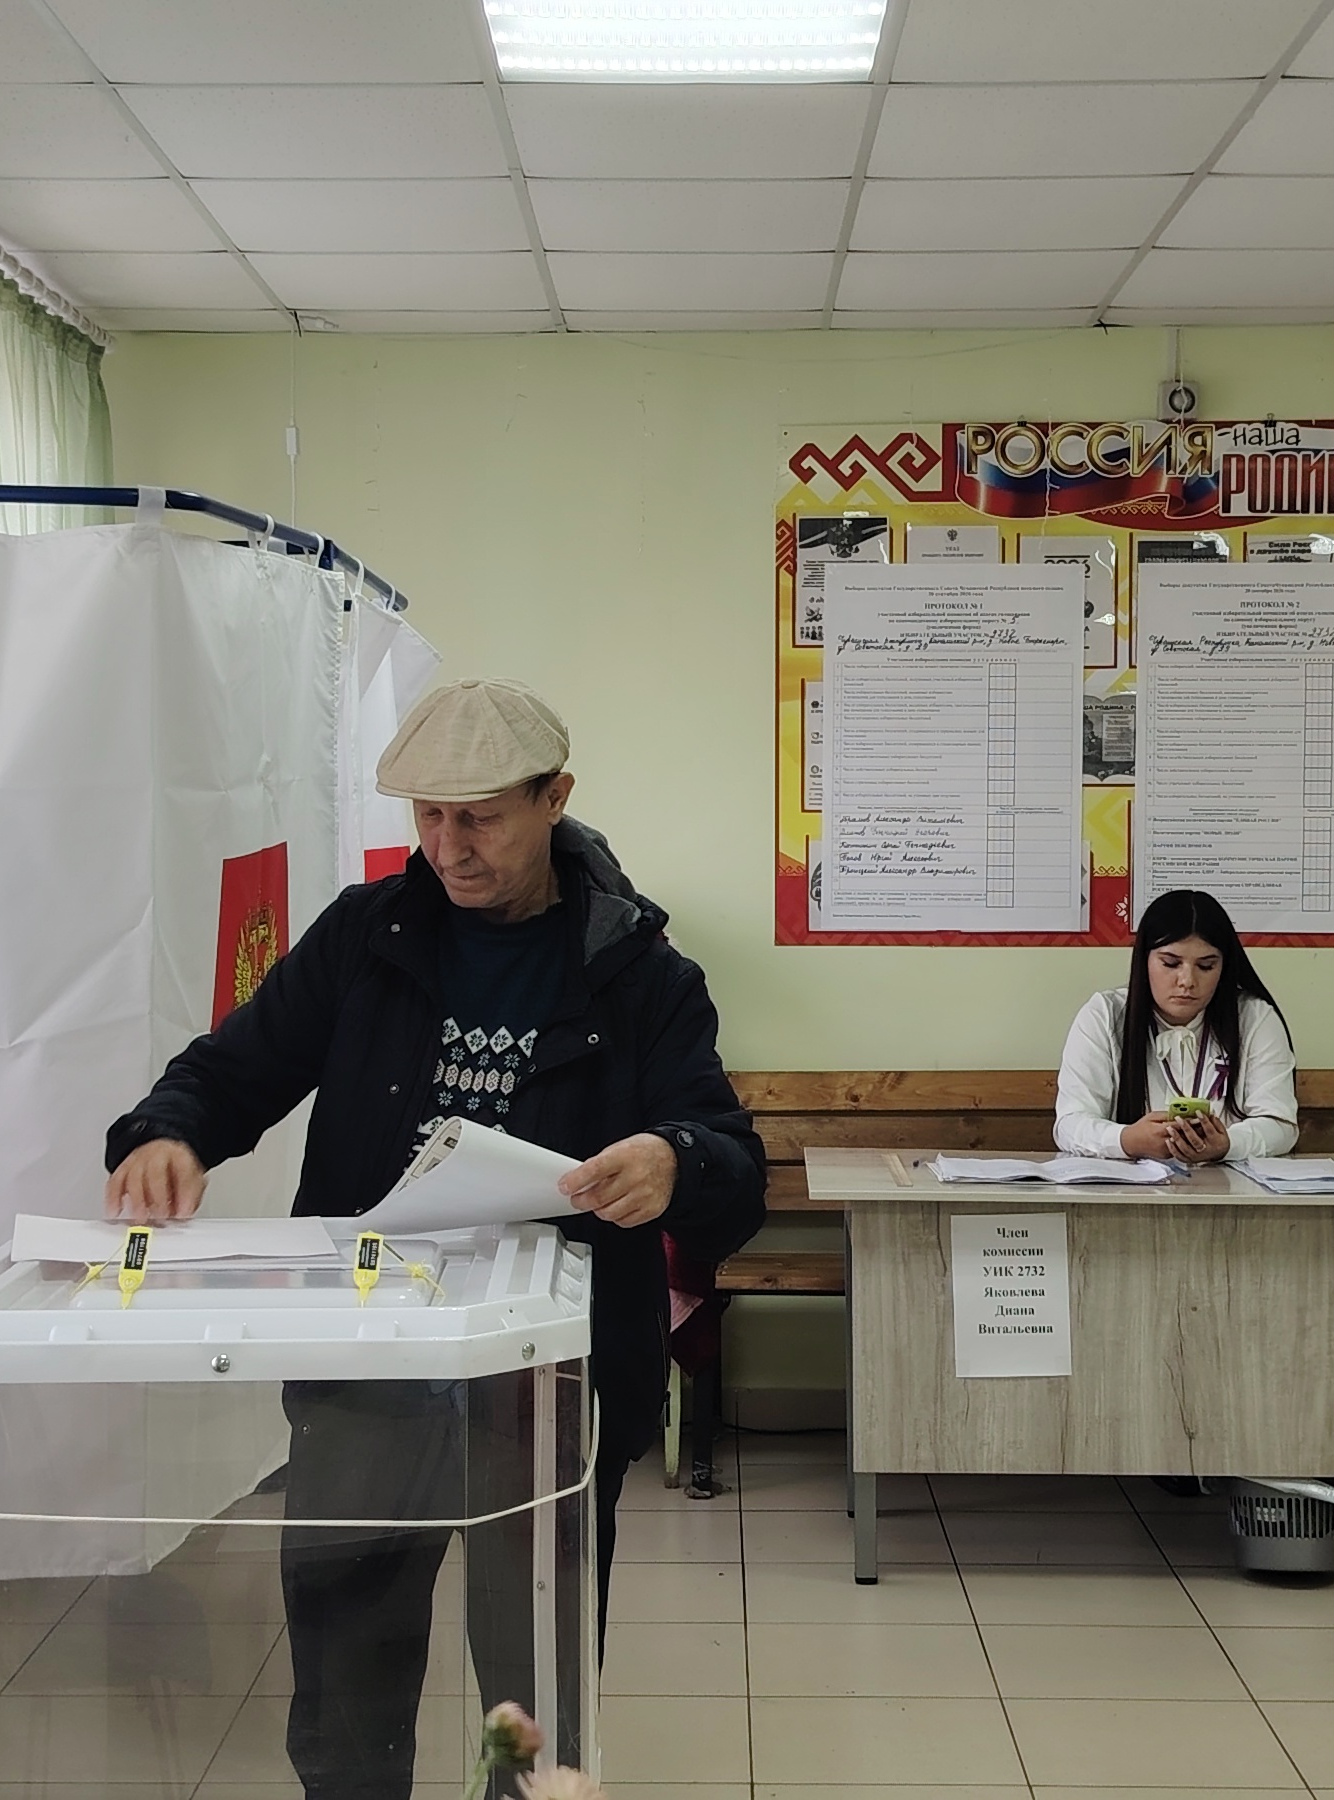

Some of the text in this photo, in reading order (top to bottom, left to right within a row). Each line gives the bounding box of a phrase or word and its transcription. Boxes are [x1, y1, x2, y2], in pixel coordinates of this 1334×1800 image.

[964, 423, 1217, 477] РОССИЯ
[924, 602, 969, 610] ПРОТОКОЛ
[1239, 601, 1285, 609] ПРОТОКОЛ
[996, 1227, 1029, 1238] Член
[982, 1247, 1045, 1257] комиссии
[982, 1265, 1046, 1277] УИК 2732
[983, 1286, 1046, 1298] Яковлева
[994, 1304, 1036, 1317] Диана
[978, 1323, 1054, 1335] Витальевна
